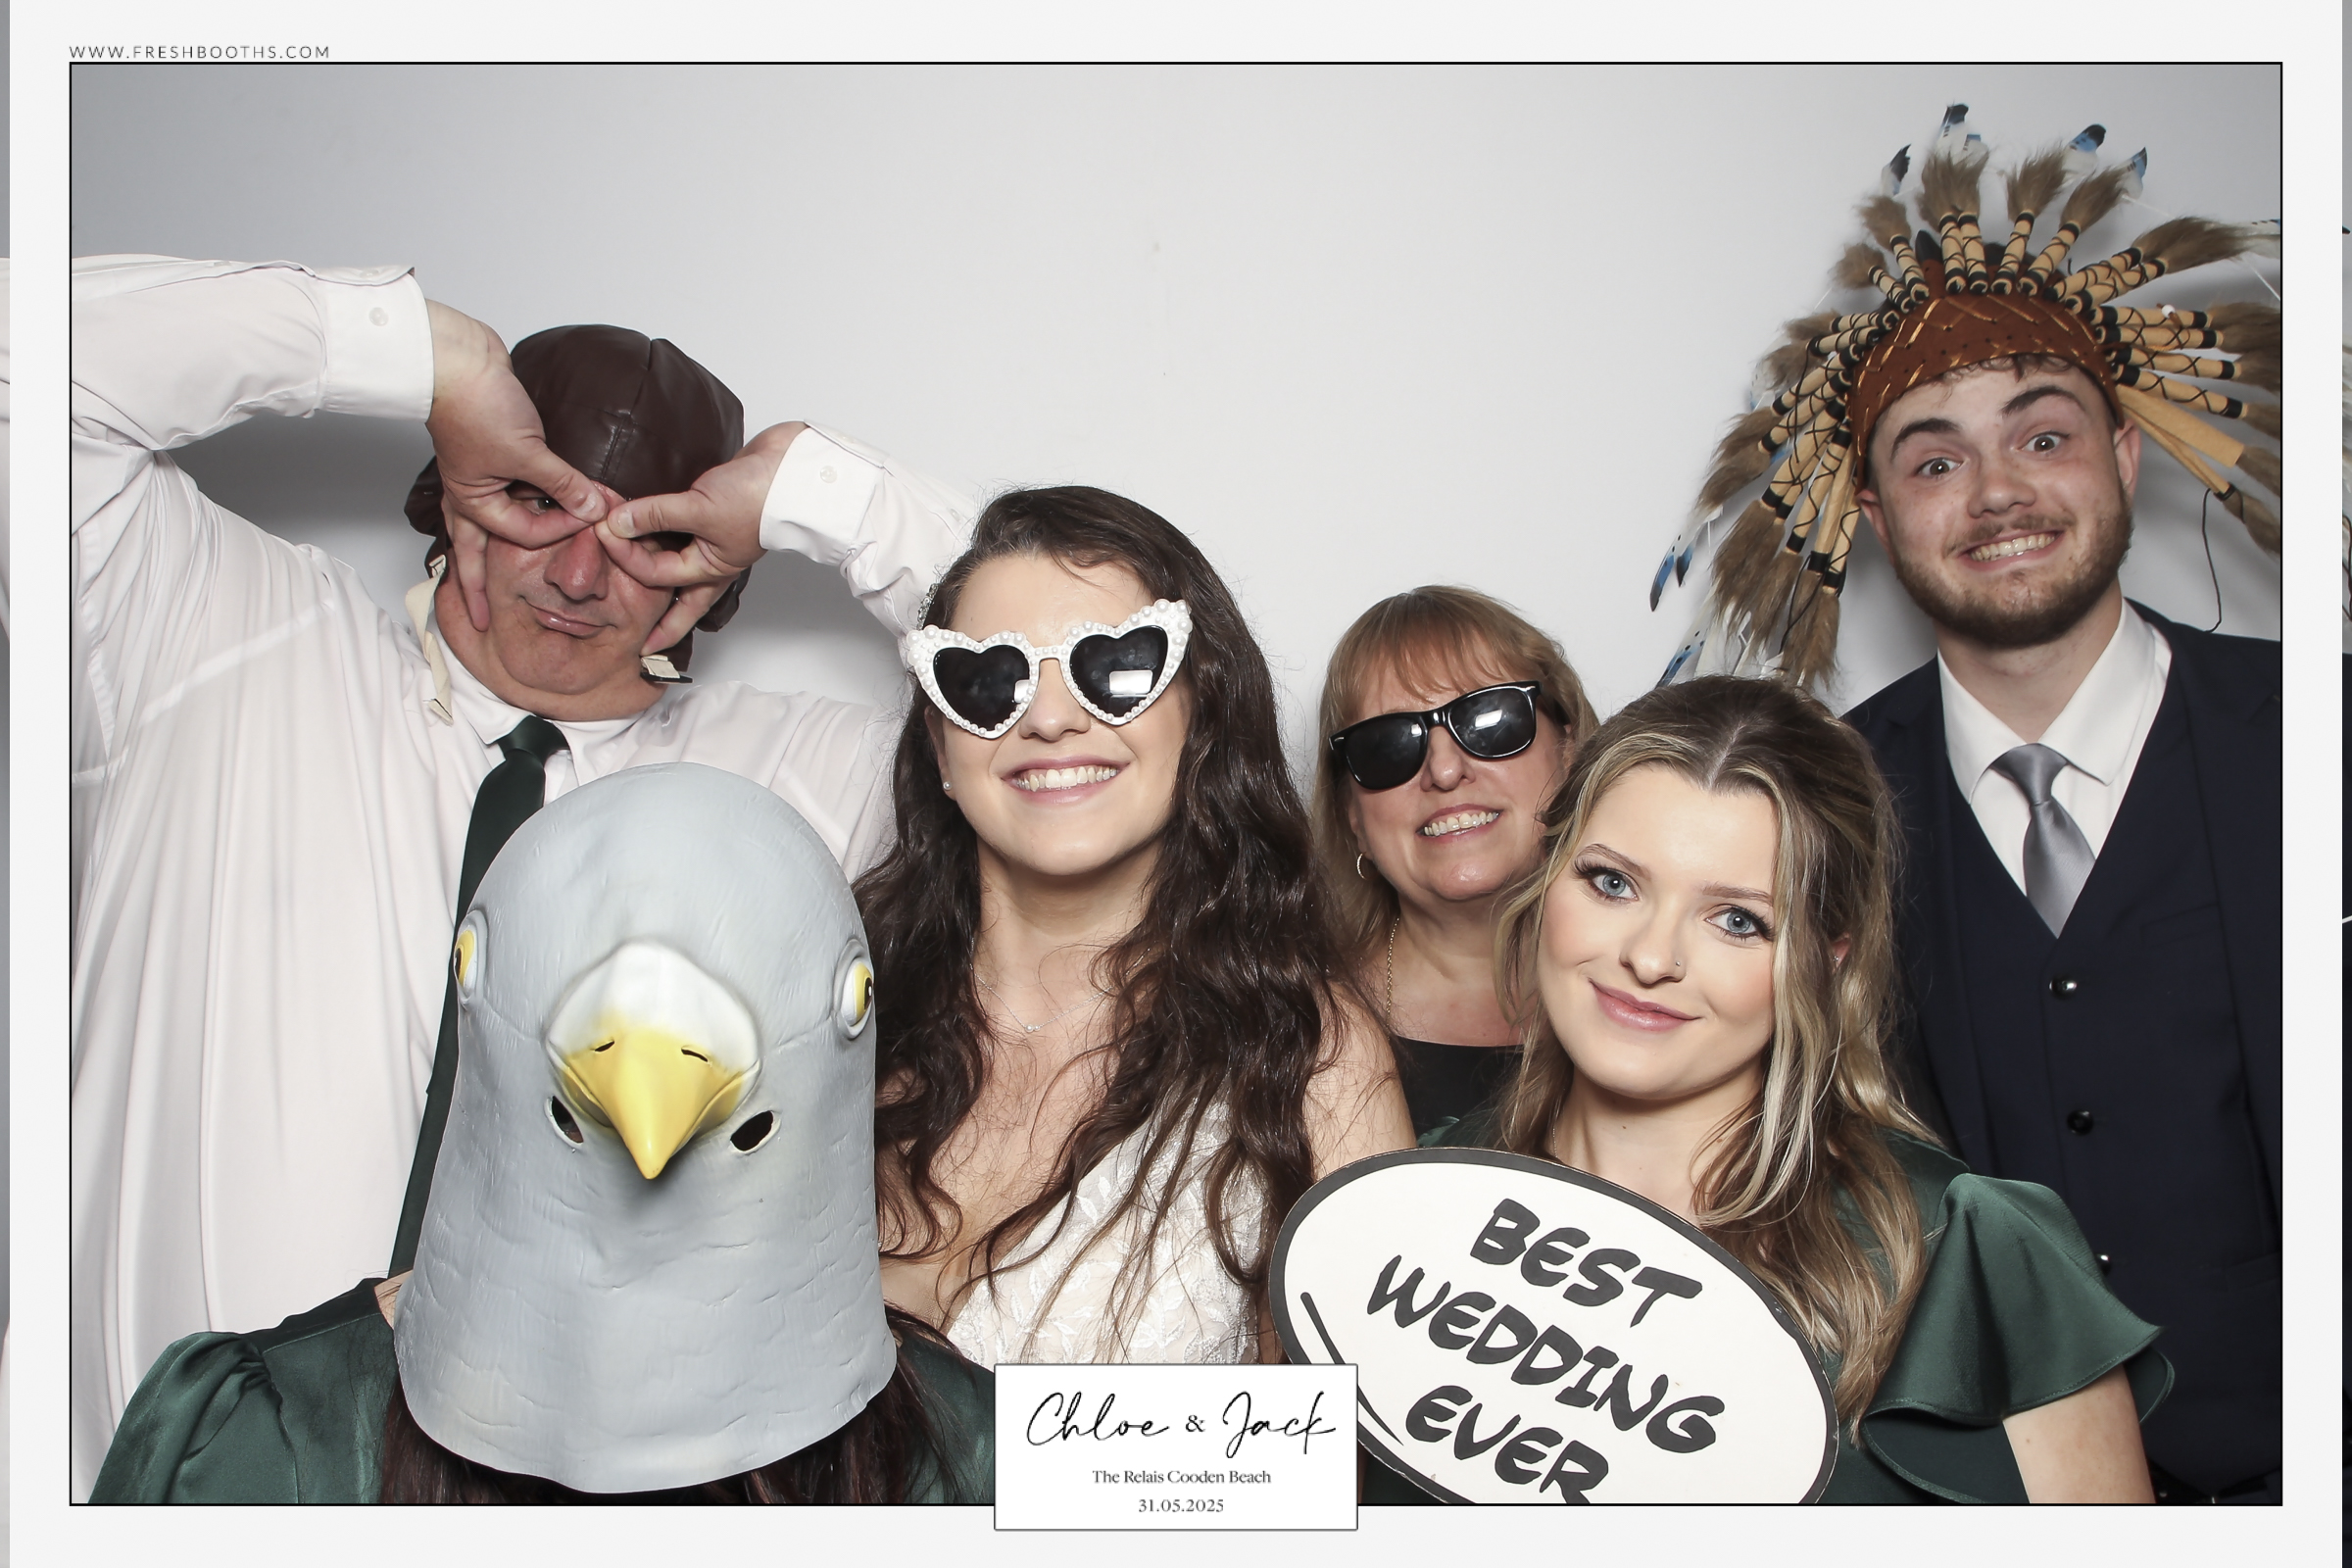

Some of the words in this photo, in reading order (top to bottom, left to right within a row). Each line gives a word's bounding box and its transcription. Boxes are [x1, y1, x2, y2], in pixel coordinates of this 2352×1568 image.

[1469, 1198, 1703, 1328] BEST
[1366, 1254, 1726, 1454] WEDDING
[1405, 1385, 1610, 1503] EVER
